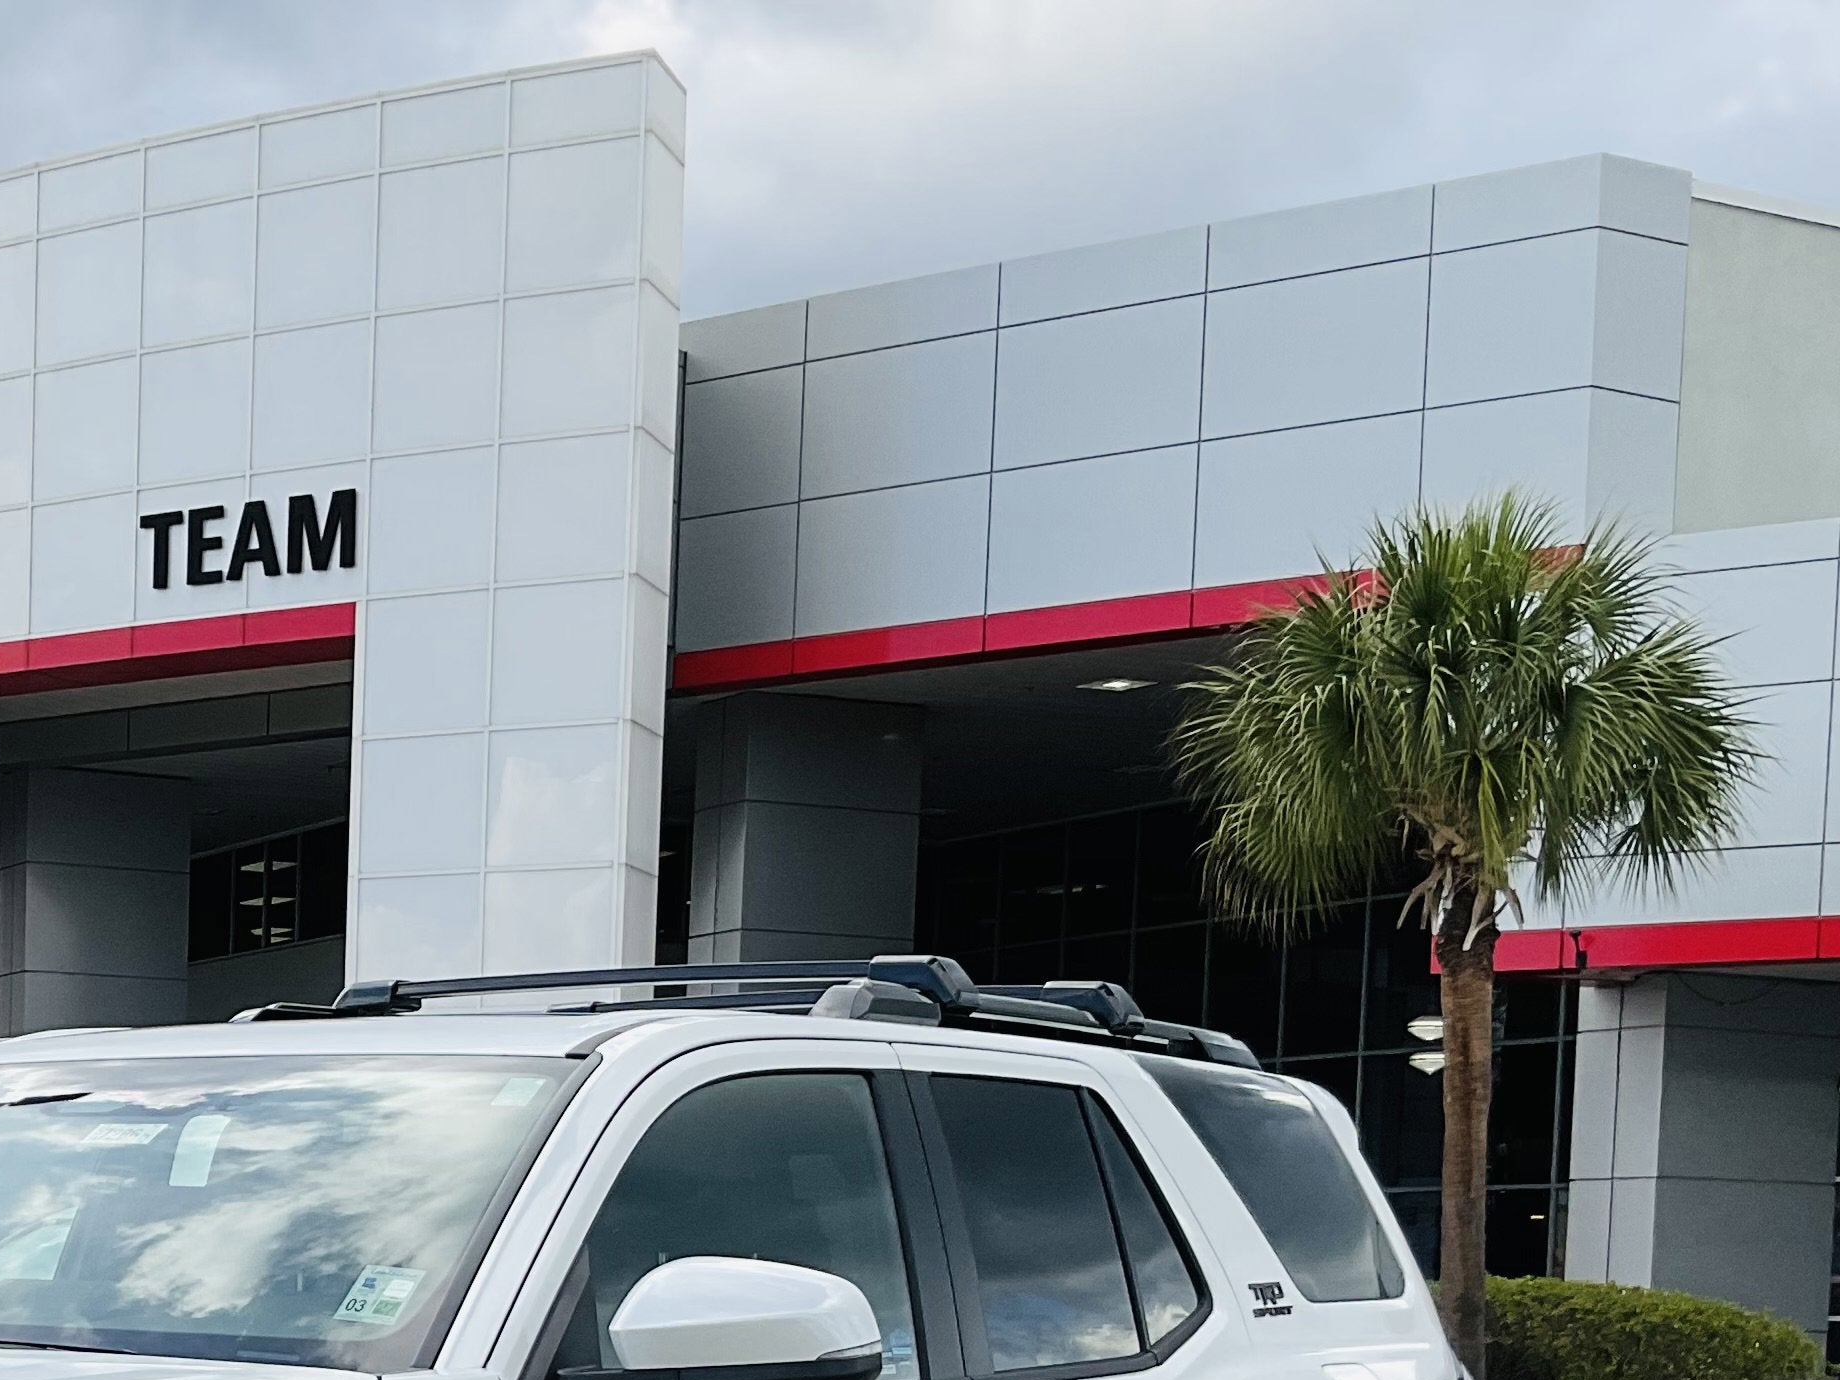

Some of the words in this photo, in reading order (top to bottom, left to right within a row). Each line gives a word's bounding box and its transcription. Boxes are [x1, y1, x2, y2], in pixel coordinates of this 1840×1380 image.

[139, 487, 357, 591] TEAM
[1247, 1281, 1285, 1305] TRD
[344, 1297, 368, 1313] 03
[1252, 1305, 1293, 1318] SPORT
